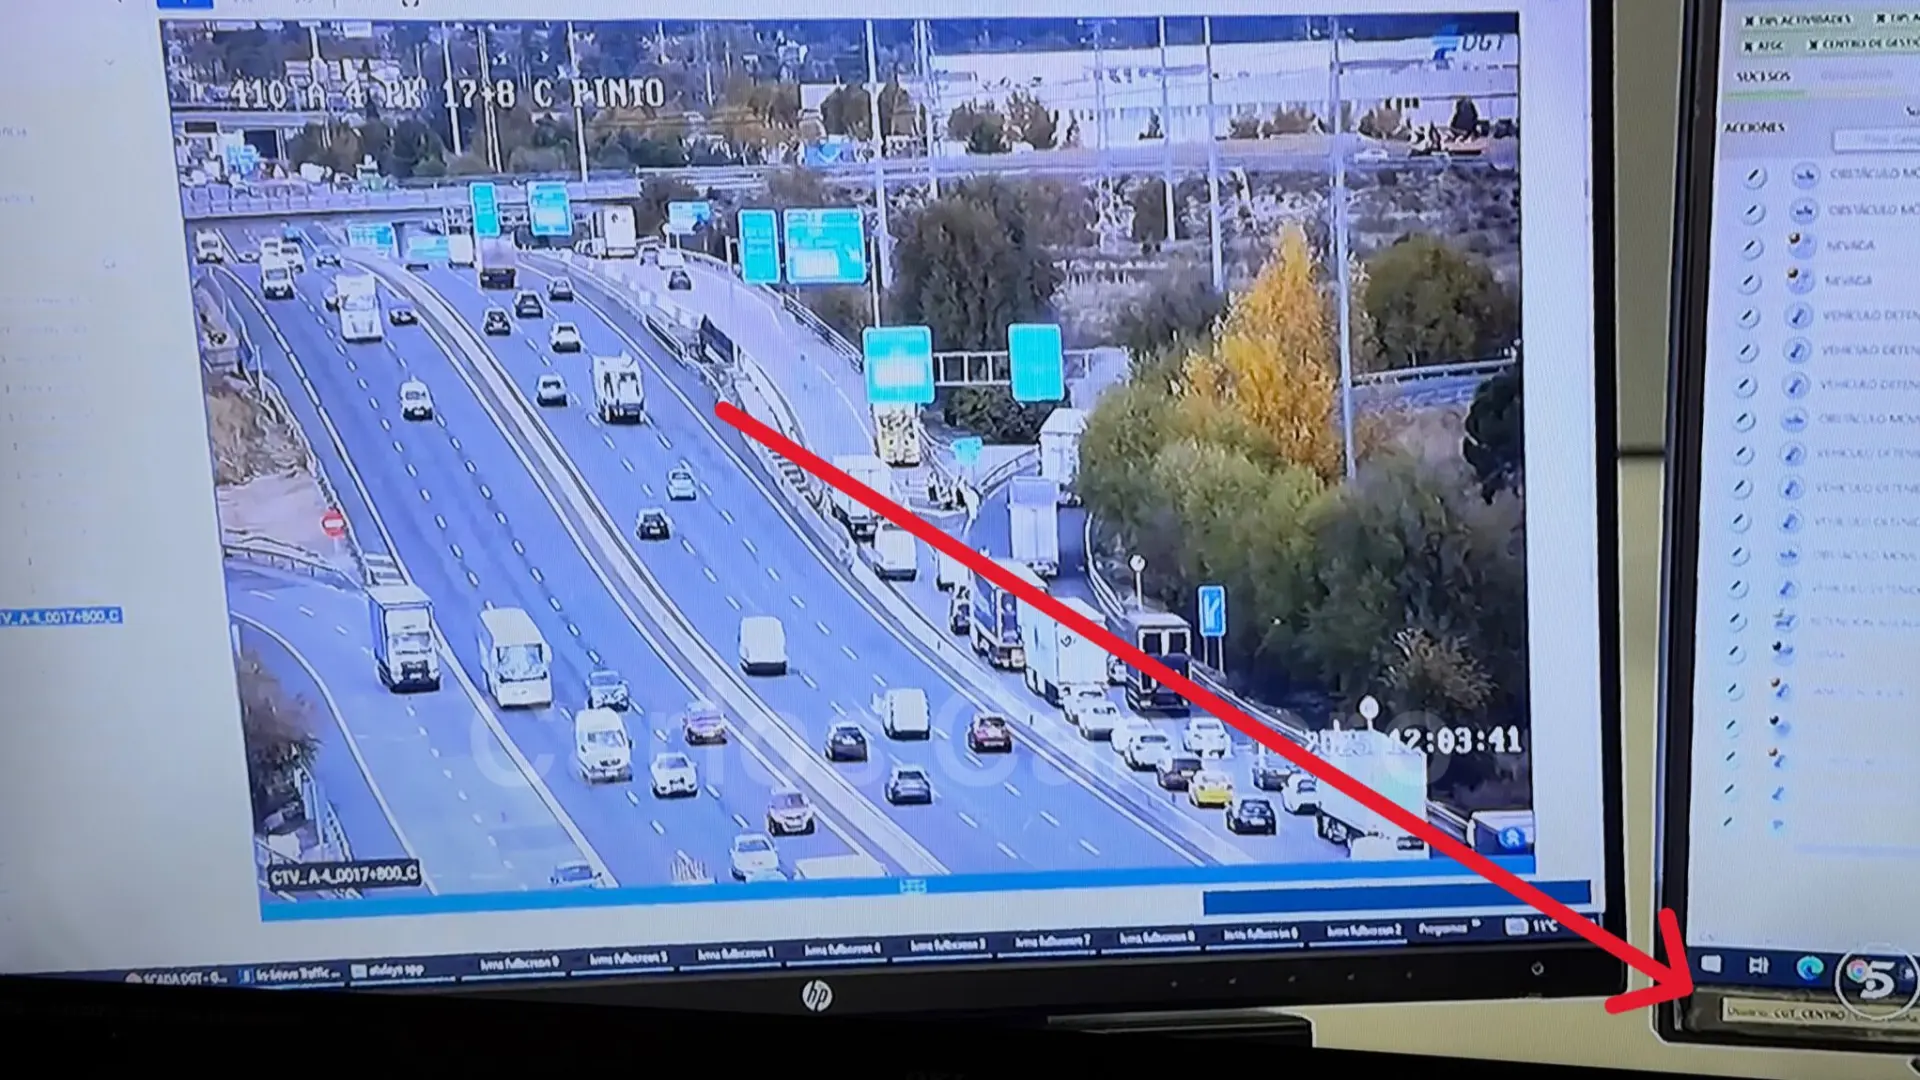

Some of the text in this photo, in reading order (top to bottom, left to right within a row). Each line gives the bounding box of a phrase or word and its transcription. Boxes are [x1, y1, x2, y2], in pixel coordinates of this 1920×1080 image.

[1736, 71, 1791, 82] SUCESOS
[231, 80, 288, 111] 410
[307, 82, 326, 109] A
[345, 81, 366, 108] 4
[385, 79, 426, 109] PK
[442, 78, 517, 109] 17+8
[533, 78, 554, 109] C
[571, 77, 665, 109] PINTO
[1724, 122, 1785, 134] ACCIONES
[1388, 724, 1523, 754] 12:03:41
[143, 972, 180, 985] SCADA
[180, 971, 203, 986] DGT
[802, 979, 833, 1012] hp
